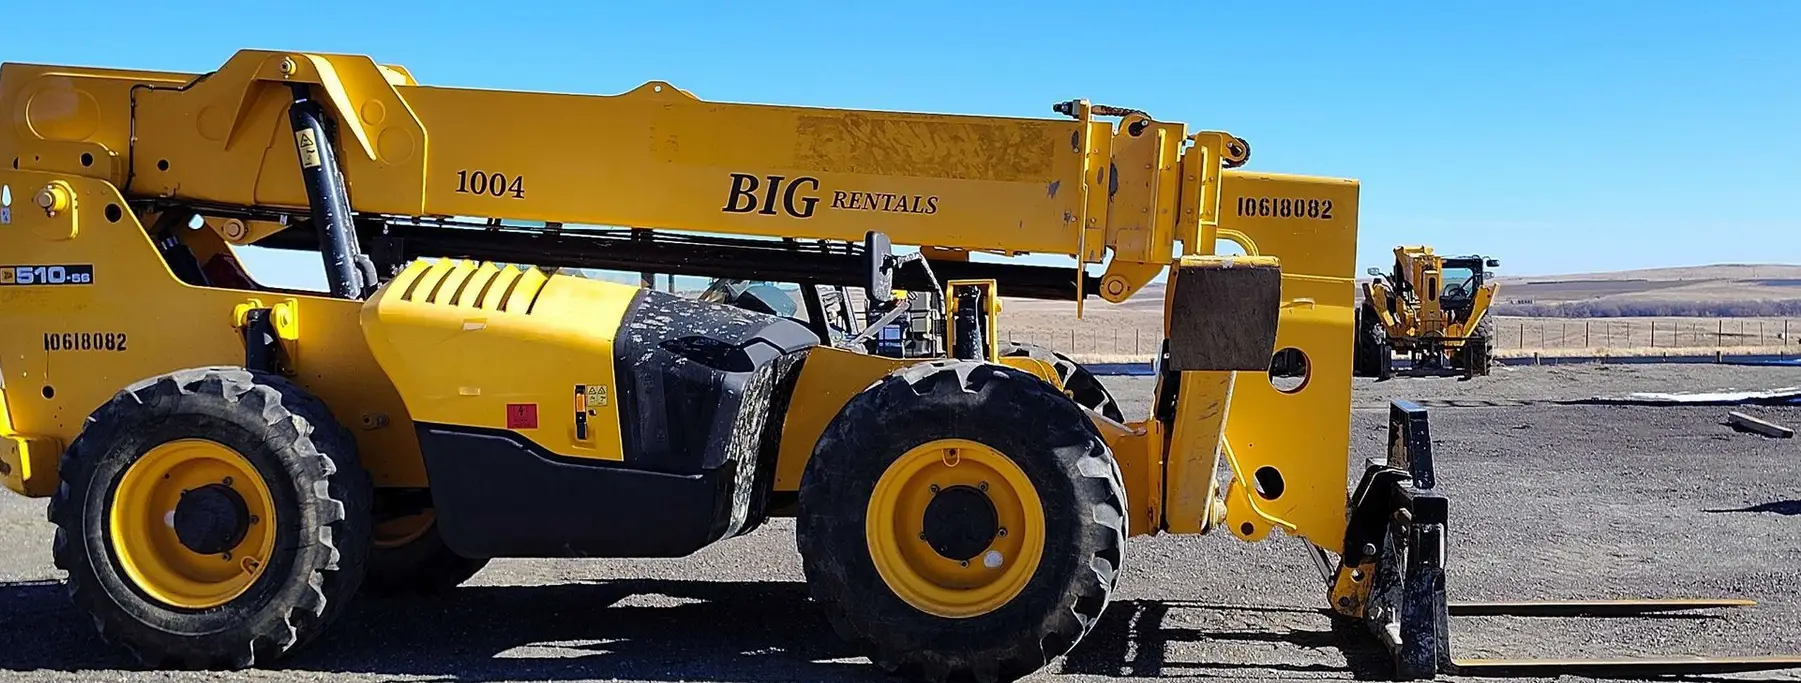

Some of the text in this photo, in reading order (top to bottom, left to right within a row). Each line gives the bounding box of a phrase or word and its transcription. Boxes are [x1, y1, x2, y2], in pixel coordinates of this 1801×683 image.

[456, 170, 525, 199] 1004
[722, 173, 939, 218] BIG RENTALS
[1237, 196, 1333, 219] 10618082
[43, 332, 127, 352] 10618082
